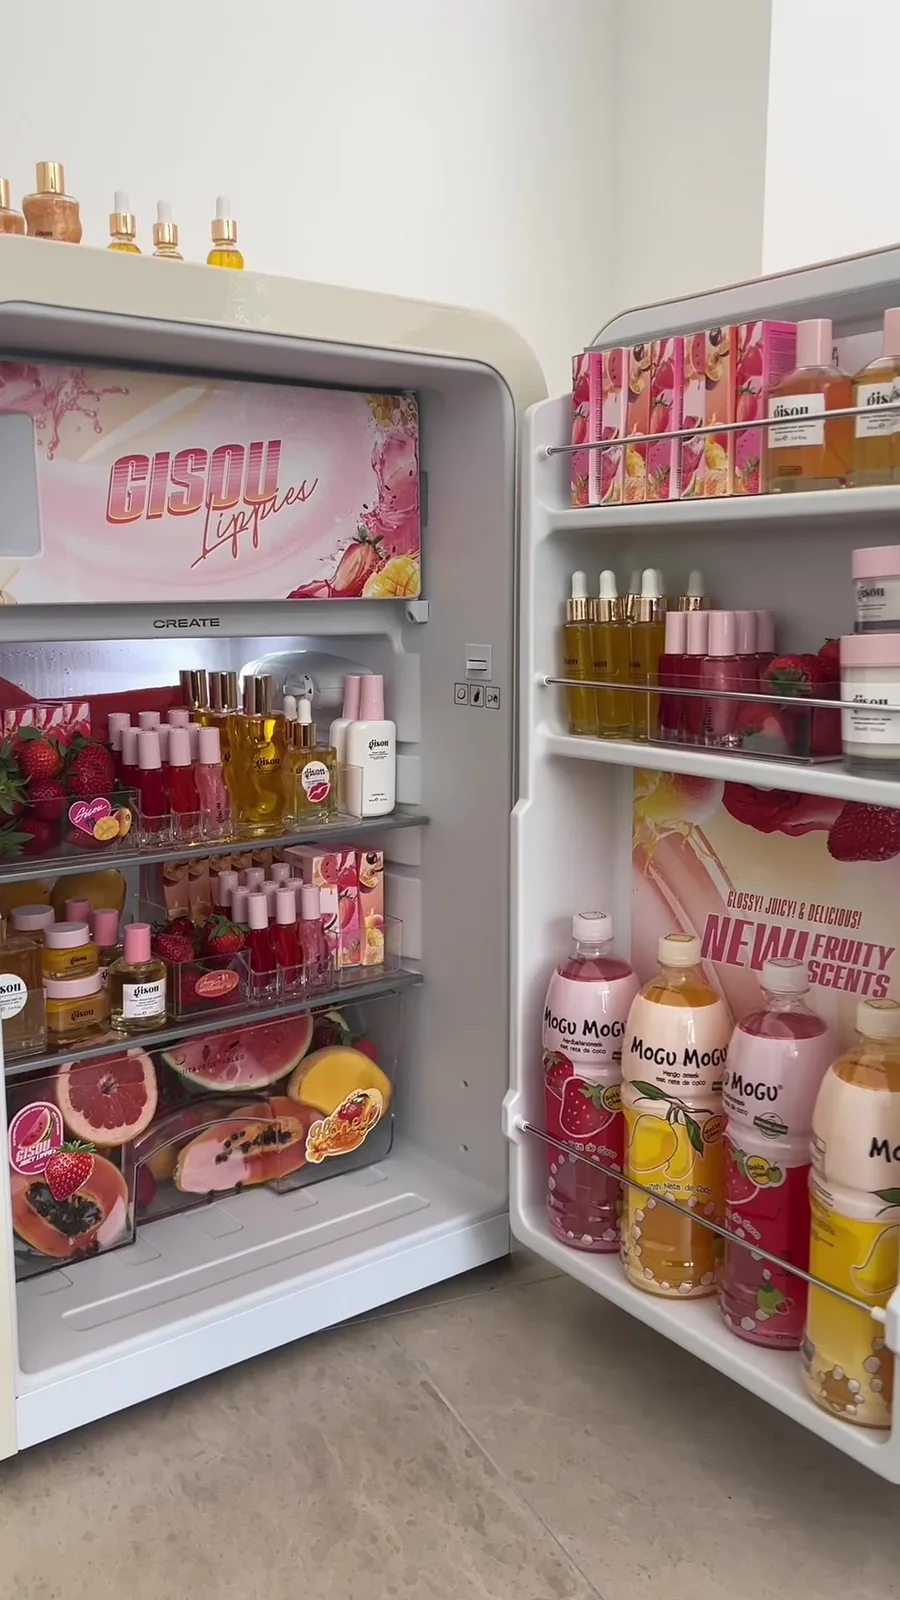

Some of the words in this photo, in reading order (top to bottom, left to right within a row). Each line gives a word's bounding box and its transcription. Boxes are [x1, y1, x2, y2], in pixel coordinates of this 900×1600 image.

[106, 439, 282, 524] GISOU
[191, 478, 318, 568] Lippies
[153, 618, 220, 628] CREATE
[727, 891, 764, 912] GLOSSY!
[765, 897, 798, 919] JUICY!
[799, 902, 805, 920] &
[807, 904, 863, 930] DELICIOUS!
[810, 933, 896, 971] FRUITY
[808, 959, 891, 998] SCENTS
[16, 1138, 51, 1162] GISOU
